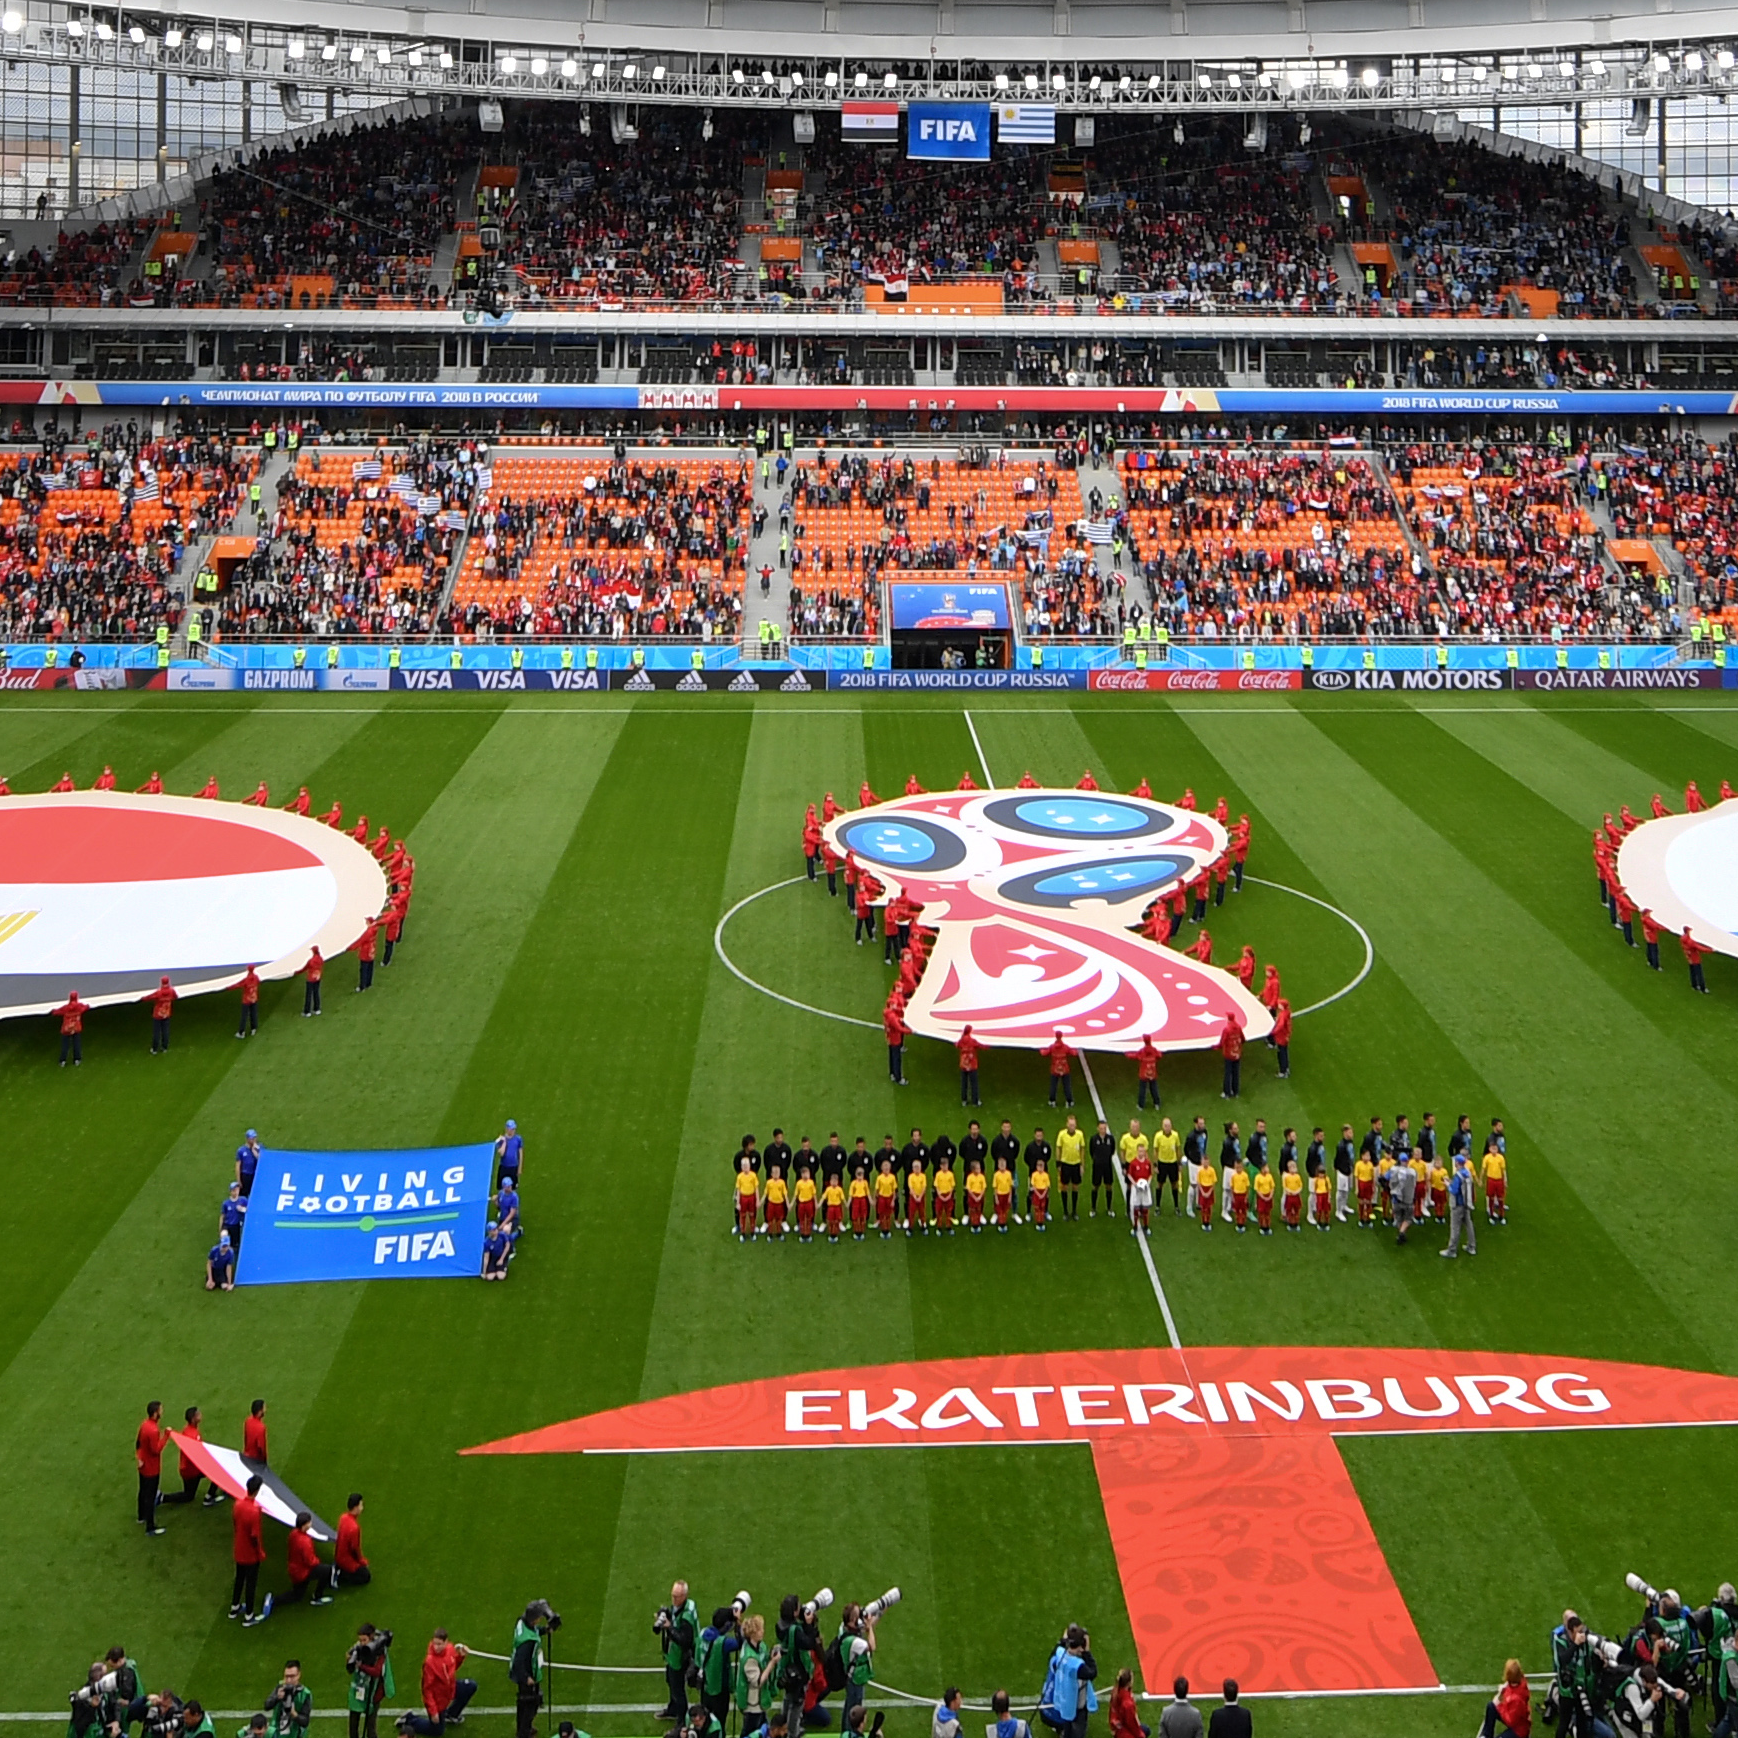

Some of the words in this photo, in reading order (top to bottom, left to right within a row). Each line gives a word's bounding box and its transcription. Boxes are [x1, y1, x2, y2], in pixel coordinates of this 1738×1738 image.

[920, 119, 977, 142] FIFA
[201, 390, 281, 403] ЧЕМПИОНАТ
[284, 390, 322, 403] МИРА
[325, 391, 343, 403] ПО
[345, 391, 406, 404] ФУТБОЛУ
[409, 391, 436, 403] FIFA
[441, 392, 470, 403] 2018
[472, 392, 481, 403] В
[485, 392, 538, 404] РОССИИ
[1382, 397, 1409, 409] 2018
[1412, 397, 1436, 409] FIFA
[1439, 397, 1482, 409] WORLD
[1485, 398, 1509, 410] CUP
[1513, 397, 1558, 410] RUSSIA
[244, 669, 314, 689] GAZPROM
[404, 670, 453, 689] VISA
[475, 670, 525, 689] VISA
[547, 670, 599, 689] VISA
[624, 682, 655, 691] adidas
[676, 682, 707, 691] adidas
[728, 682, 759, 691] adidas
[780, 682, 811, 691] adidas
[840, 673, 876, 687] 2018
[879, 673, 912, 687] FIFA
[915, 673, 971, 687] WORLD
[975, 673, 1007, 687] CUP
[1010, 673, 1070, 688] RUSSIA
[1096, 670, 1149, 689] Coca-Cola
[1167, 670, 1220, 689] Coca-Cola
[1239, 670, 1292, 689] Coca-Cola
[1320, 673, 1344, 687] KIA
[1355, 671, 1395, 689] KIA
[1403, 671, 1502, 689] MOTORS
[1534, 670, 1605, 690] QATAR
[1611, 670, 1700, 689] AIRWAYS
[280, 1165, 465, 1193] LIVING
[373, 1229, 457, 1265] FIFA
[783, 1372, 1613, 1432] EKATERINBURG
